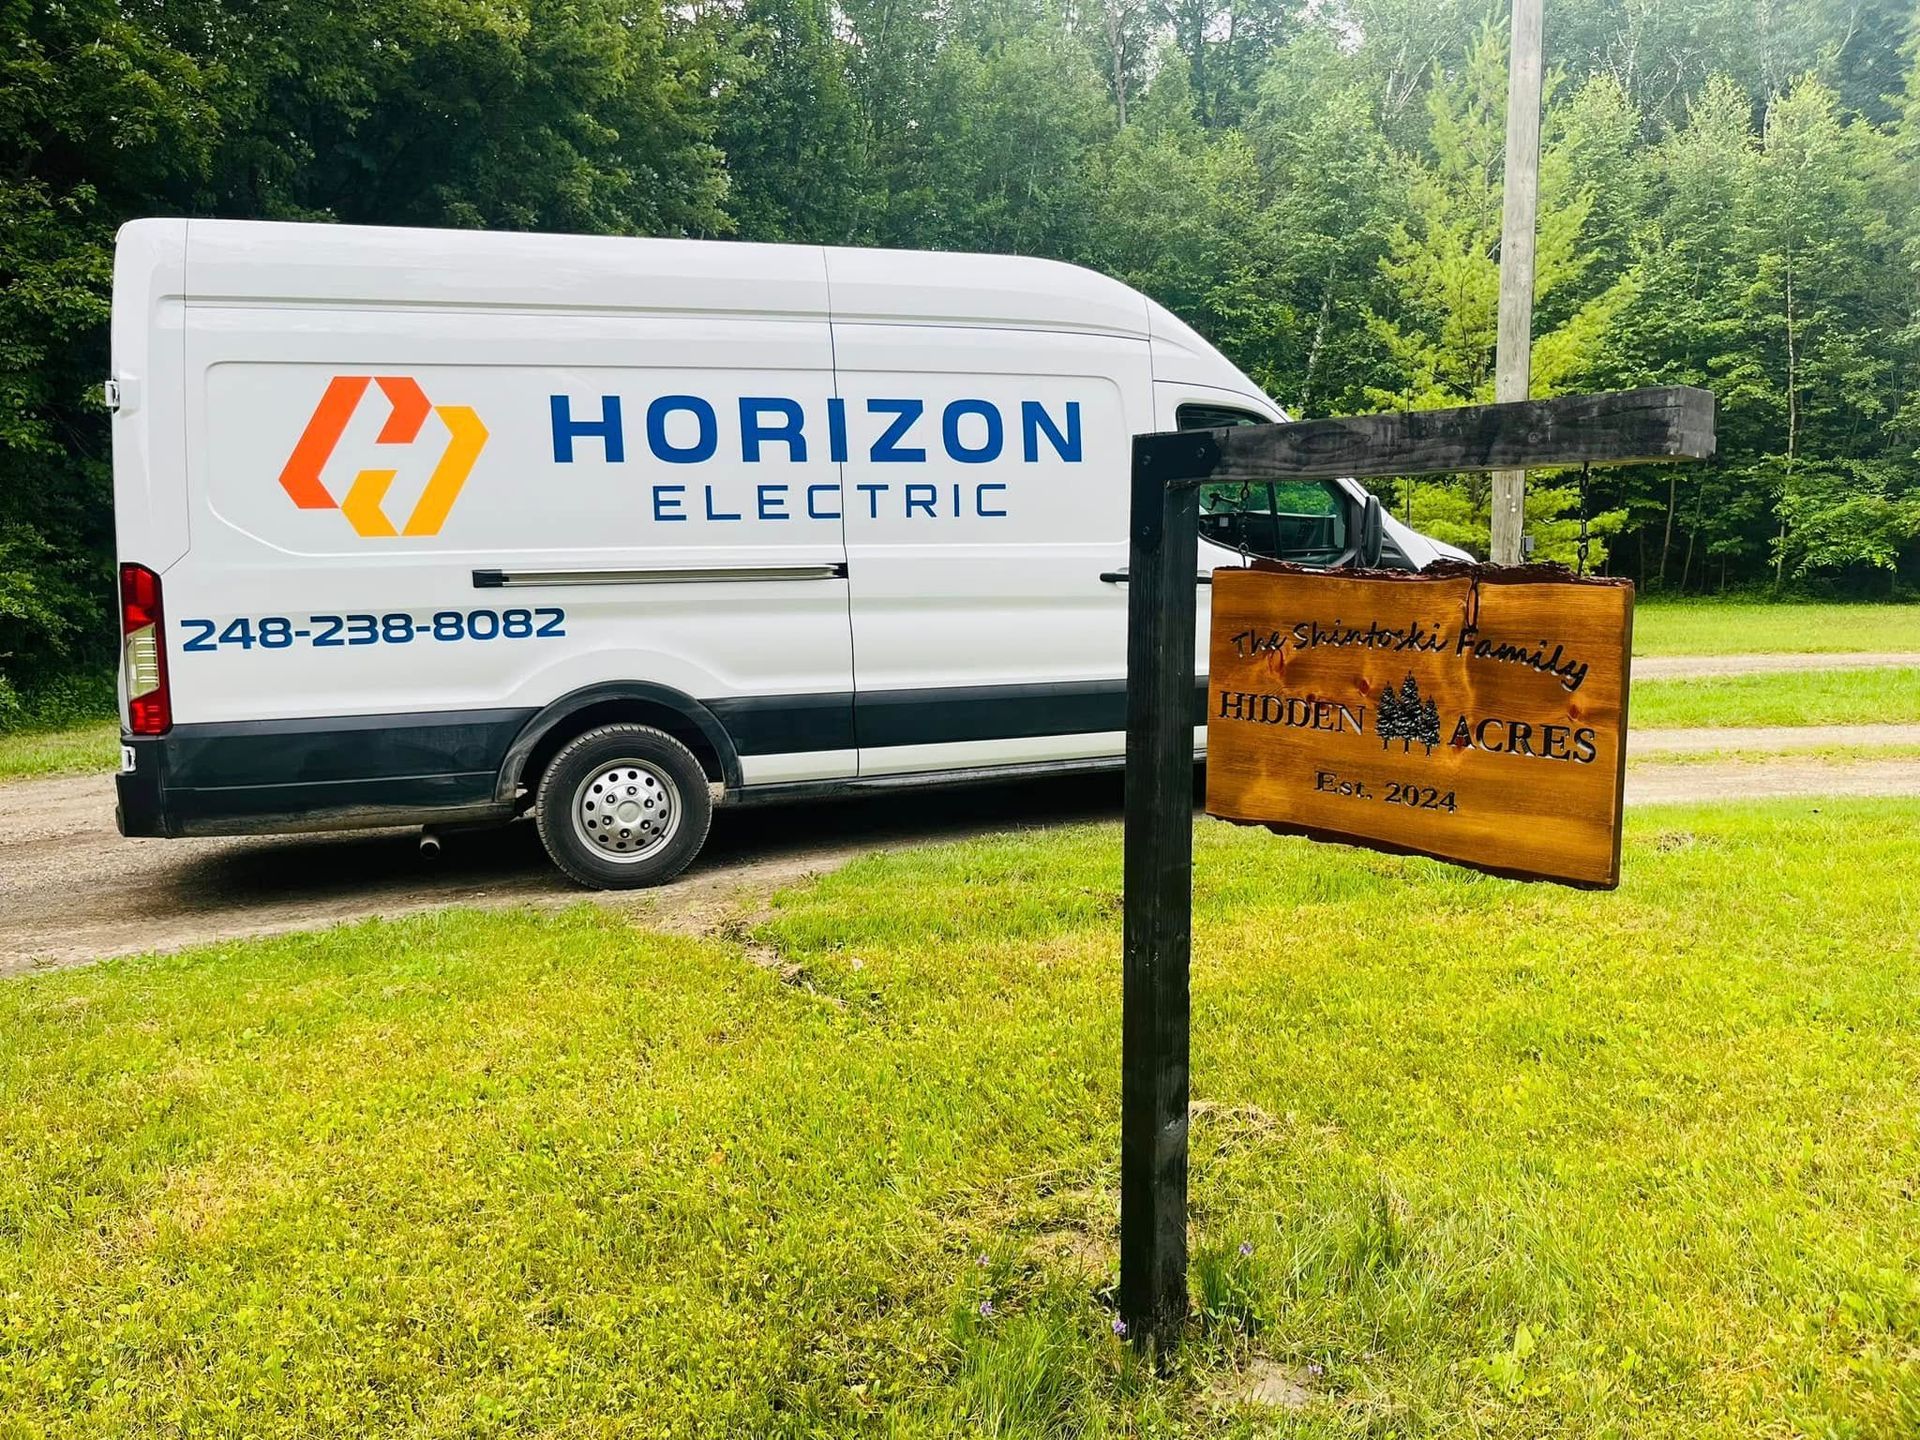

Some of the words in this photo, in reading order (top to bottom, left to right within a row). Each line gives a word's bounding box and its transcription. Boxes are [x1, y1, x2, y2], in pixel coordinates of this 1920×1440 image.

[550, 395, 1082, 463] HORIZON
[652, 484, 1007, 521] ELECTRIC
[180, 607, 566, 652] 248-238-8082
[1230, 629, 1287, 658] The
[1292, 619, 1447, 652] Shintoski
[1456, 628, 1590, 692] Family
[1218, 690, 1365, 735] HIDDEN
[1448, 715, 1597, 764] ACRES
[1313, 770, 1373, 800] Est.
[1384, 782, 1458, 814] 2024
